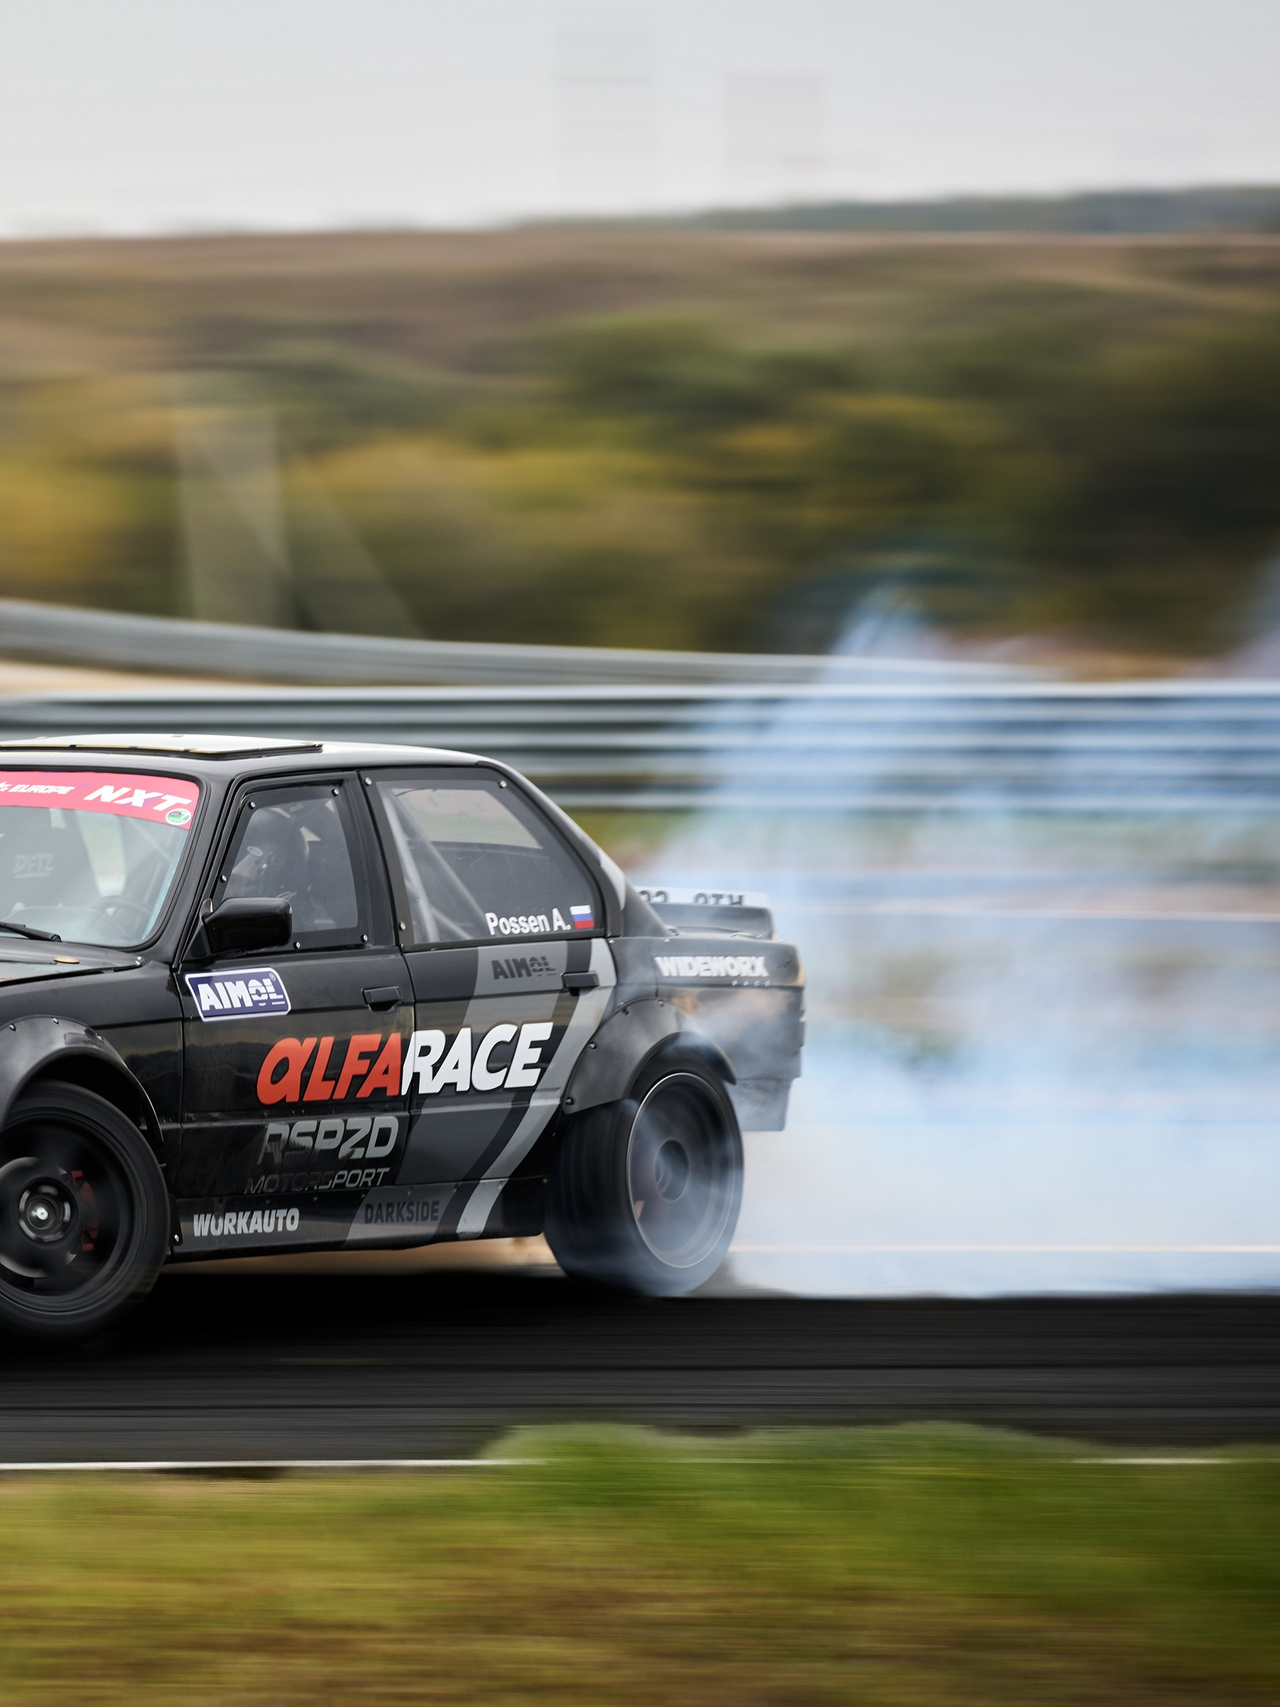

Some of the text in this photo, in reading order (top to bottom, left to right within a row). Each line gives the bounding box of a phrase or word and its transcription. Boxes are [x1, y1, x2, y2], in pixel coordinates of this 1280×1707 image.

[7, 784, 76, 795] EUROPE
[83, 785, 192, 812] NXT
[485, 907, 572, 936] Possen A.
[491, 956, 558, 980] AIMOL
[654, 955, 770, 978] WIDEWORX
[197, 977, 287, 1011] AIMOL
[243, 1166, 391, 1195] MOTORSPORT
[193, 1207, 300, 1237] WORKAUTO
[364, 1201, 440, 1225] DARKSIDE
